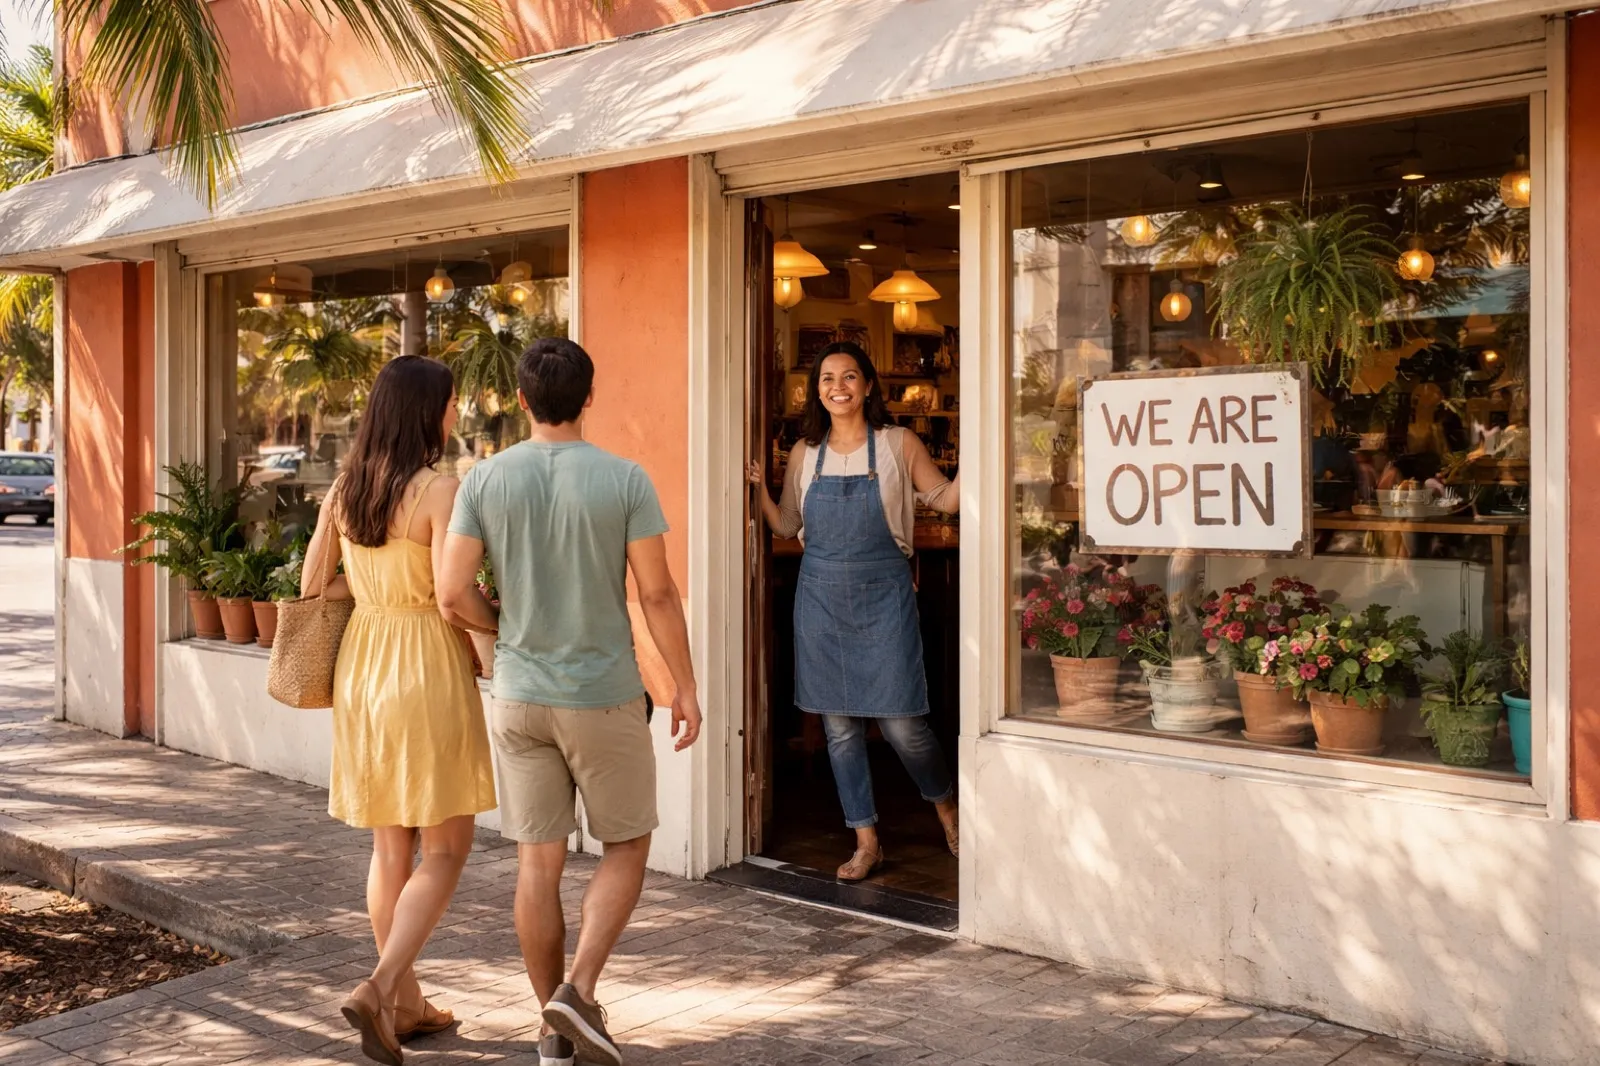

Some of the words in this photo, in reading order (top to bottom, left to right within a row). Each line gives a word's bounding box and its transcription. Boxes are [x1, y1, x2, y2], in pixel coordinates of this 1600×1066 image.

[1101, 399, 1173, 446] WE
[1188, 394, 1278, 444] ARE
[1105, 461, 1275, 526] OPEN
